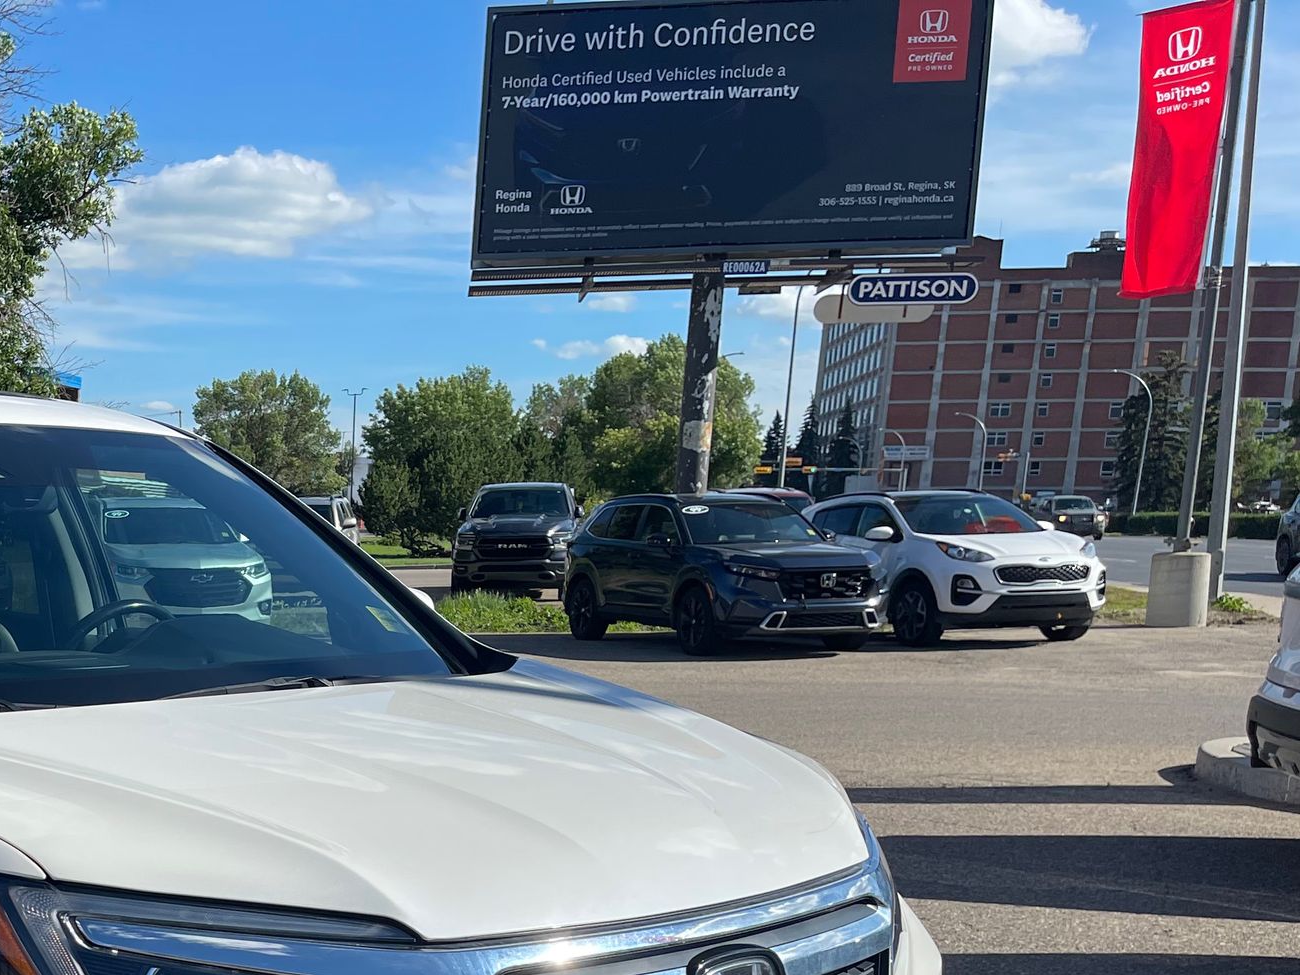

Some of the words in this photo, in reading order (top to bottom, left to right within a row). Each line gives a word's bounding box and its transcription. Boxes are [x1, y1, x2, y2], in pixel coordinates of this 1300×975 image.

[504, 27, 576, 55] Drive
[584, 22, 645, 50] with
[654, 17, 816, 48] Confidence
[907, 35, 958, 44] HONDA
[908, 51, 954, 64] Certified
[502, 73, 548, 89] Honda
[551, 70, 613, 87] Certified
[616, 69, 653, 84] Used
[656, 66, 717, 82] Vehicles
[720, 63, 774, 79] include
[777, 65, 787, 77] a
[501, 90, 611, 110] 7-Year/160,000
[613, 89, 638, 104] km
[641, 85, 724, 102] Powertrain
[727, 83, 800, 100] Warranty
[864, 181, 891, 192] Broad
[944, 180, 957, 189] SK
[495, 189, 532, 201] Regina
[818, 195, 877, 207] 306-525-1555
[884, 193, 955, 206] reginahonda.ca
[495, 203, 530, 213] Honda
[549, 206, 594, 215] HONDA
[722, 261, 766, 273] RE00062A
[858, 279, 969, 298] PATTISON
